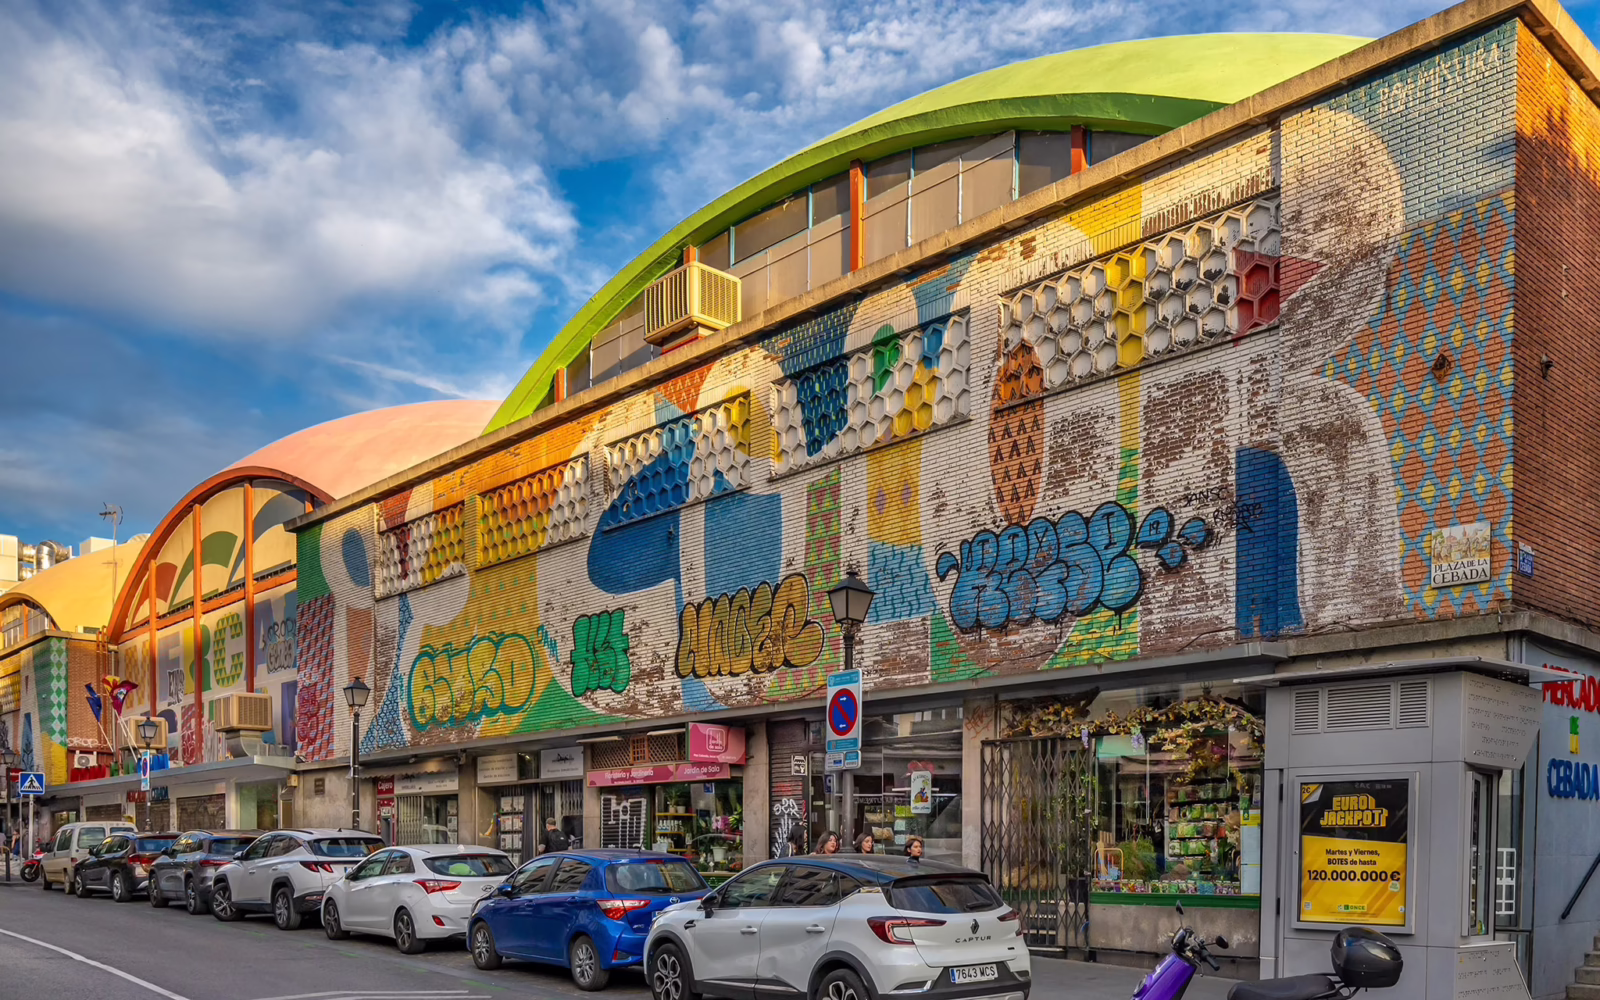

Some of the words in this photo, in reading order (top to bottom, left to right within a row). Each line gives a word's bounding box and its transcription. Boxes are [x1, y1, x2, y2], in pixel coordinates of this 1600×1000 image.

[1434, 561, 1466, 573] PLAZA
[1467, 560, 1476, 568] DE
[1478, 558, 1488, 566] LA
[1433, 568, 1488, 585] CEBADA
[701, 765, 708, 774] de
[708, 764, 720, 773] Sala
[1547, 758, 1600, 800] CEBADA
[377, 781, 393, 792] Cajero
[1333, 794, 1371, 811] EURO
[1320, 810, 1385, 827] JACKPOT
[1353, 849, 1380, 857] Viernes,
[1327, 858, 1348, 866] BOTES
[1350, 858, 1357, 866] de
[1359, 858, 1377, 866] hasta
[955, 935, 992, 943] CAPTUR
[956, 967, 978, 980] 7643
[979, 966, 996, 977] MCS
